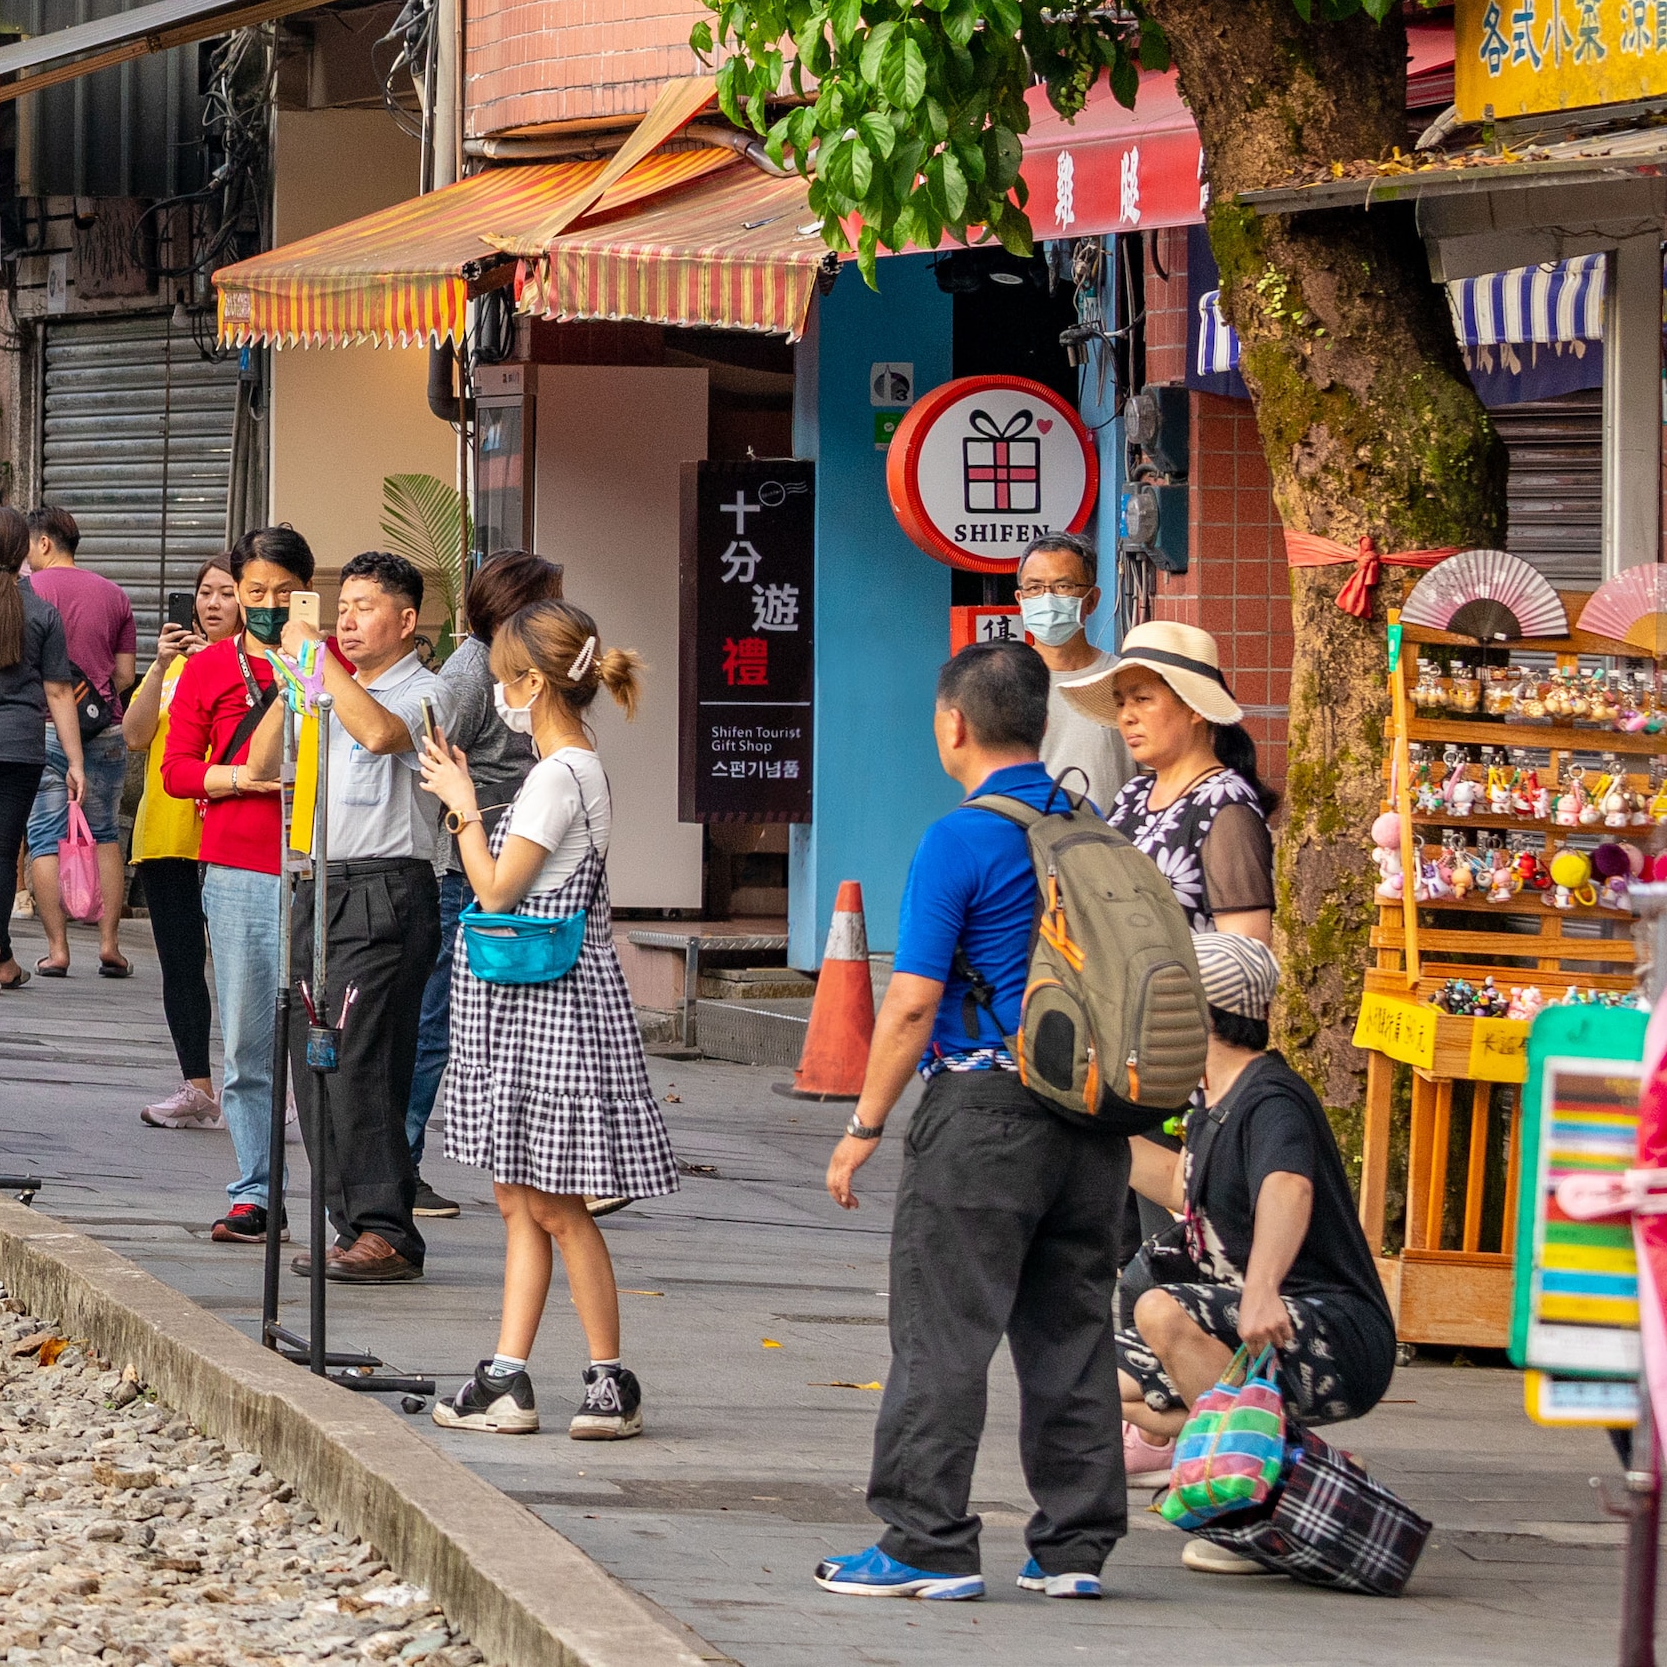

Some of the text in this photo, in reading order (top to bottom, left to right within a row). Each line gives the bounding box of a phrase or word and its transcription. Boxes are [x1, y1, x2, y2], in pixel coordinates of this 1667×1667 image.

[711, 725, 801, 739] Shifen Tourist
[711, 739, 773, 755] Gift Shop
[710, 759, 800, 780] 스펀기념품
